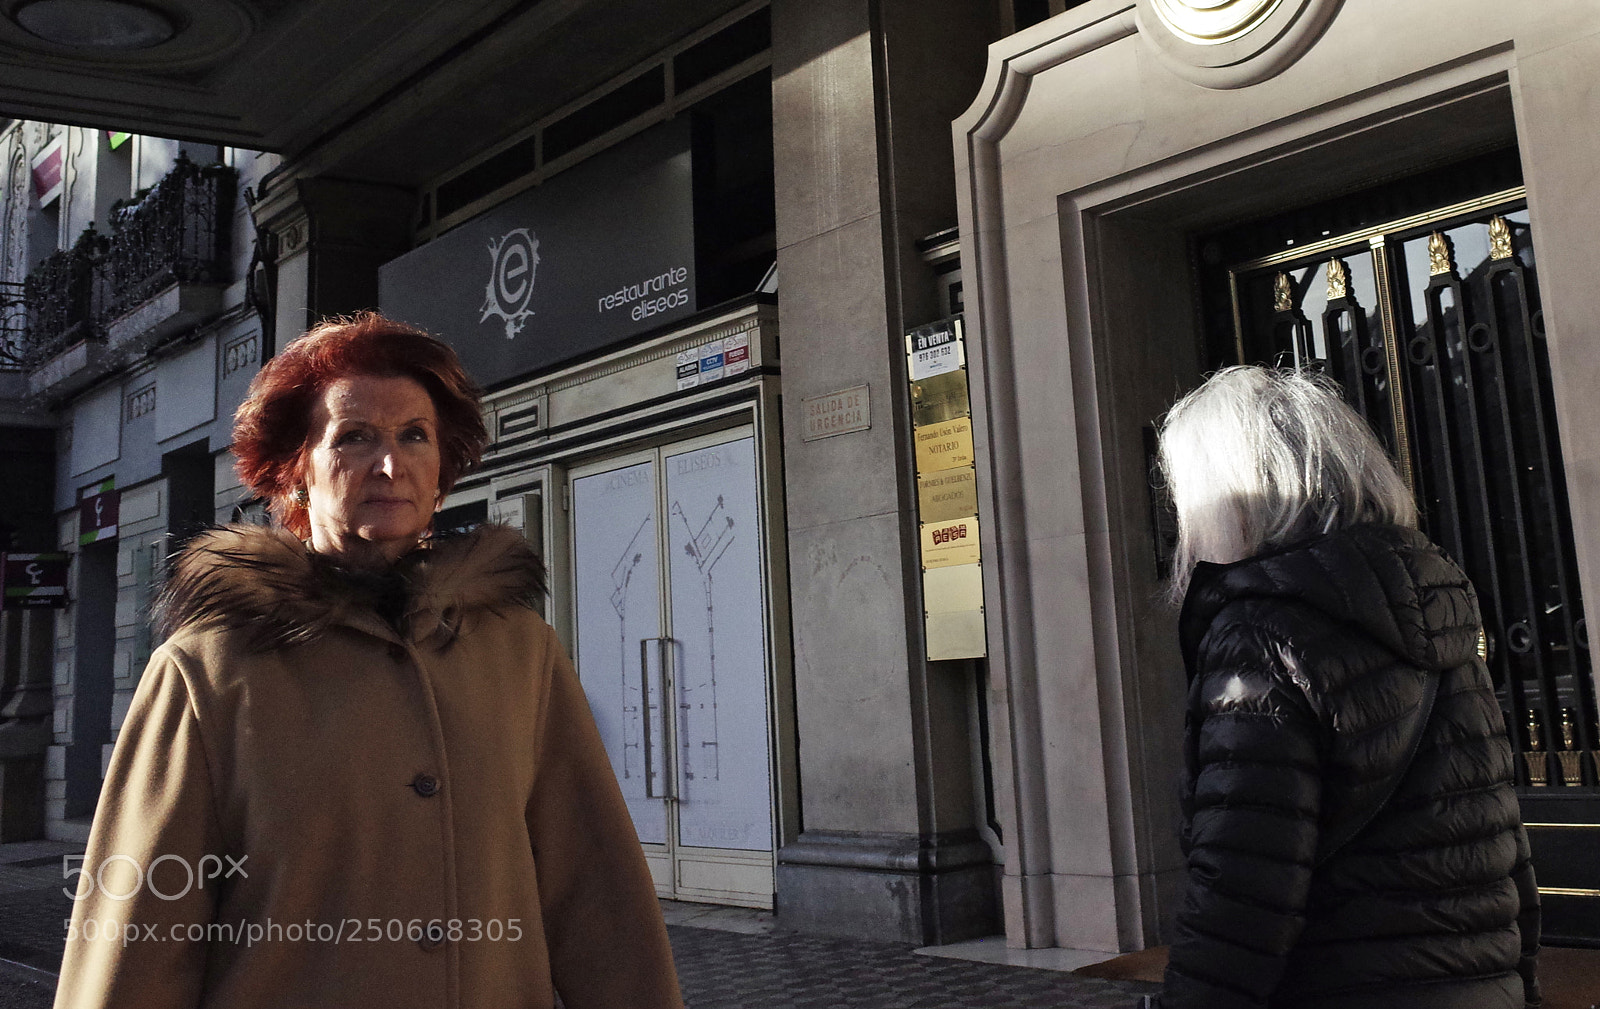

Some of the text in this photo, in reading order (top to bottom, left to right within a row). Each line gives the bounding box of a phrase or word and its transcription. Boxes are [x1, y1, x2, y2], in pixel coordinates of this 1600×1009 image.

[598, 266, 688, 312] restaurante
[631, 288, 689, 322] eliseos
[918, 331, 950, 349] EN VENTA
[809, 394, 860, 416] SALIDA DE
[809, 410, 862, 432] URGENCIA
[918, 430, 939, 441] Fernando
[928, 441, 959, 455] NOTARIO
